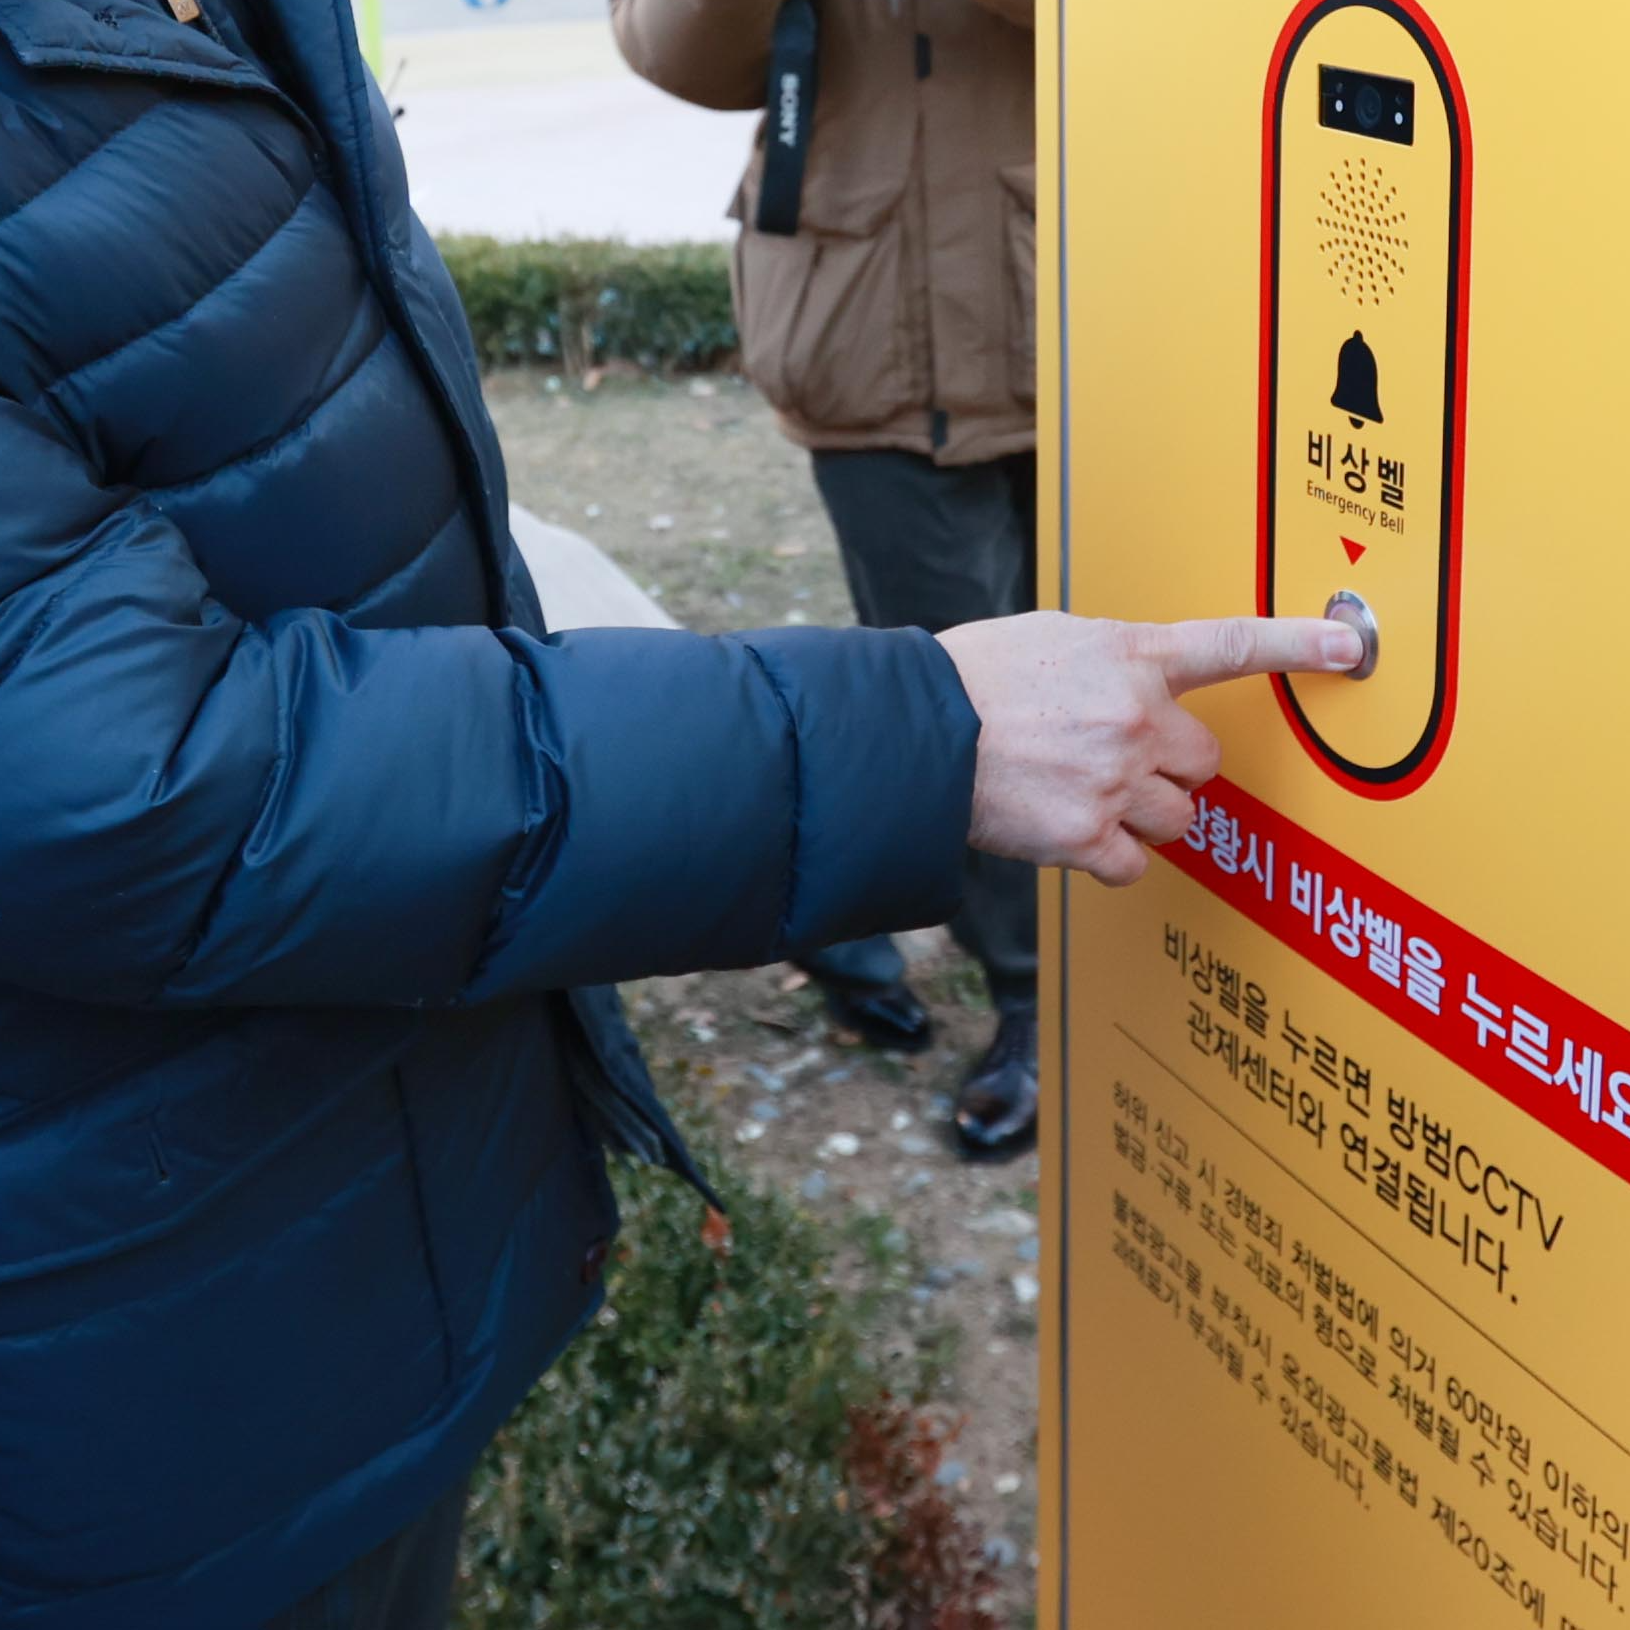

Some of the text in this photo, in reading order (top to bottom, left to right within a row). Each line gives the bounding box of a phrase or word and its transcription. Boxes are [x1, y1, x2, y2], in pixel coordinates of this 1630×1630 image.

[1306, 480, 1405, 535] Emergency Bell
[1307, 430, 1405, 511] 비상벨
[1290, 861, 1446, 1016] 비상벨을
[1163, 922, 1564, 1252] 비상벨을 누르면 방범CCTV
[1186, 1000, 1518, 1306] 관제센터와 연결됩니다.
[1113, 1080, 1630, 1562] 허위 신고 시 경범죄 처벌법에 의거 60만원 이하의
[1199, 1201, 1238, 1259] 또는
[1243, 1242, 1305, 1323] 과료의
[1313, 1303, 1379, 1390] 형으로
[1387, 1374, 1460, 1465] 처벌될
[1469, 1451, 1496, 1488] 수
[1506, 1477, 1626, 1614] 있습니다.
[1251, 1370, 1273, 1407] 수
[1279, 1396, 1371, 1512] 있습니다.
[1431, 1494, 1546, 1630] 제20조에
